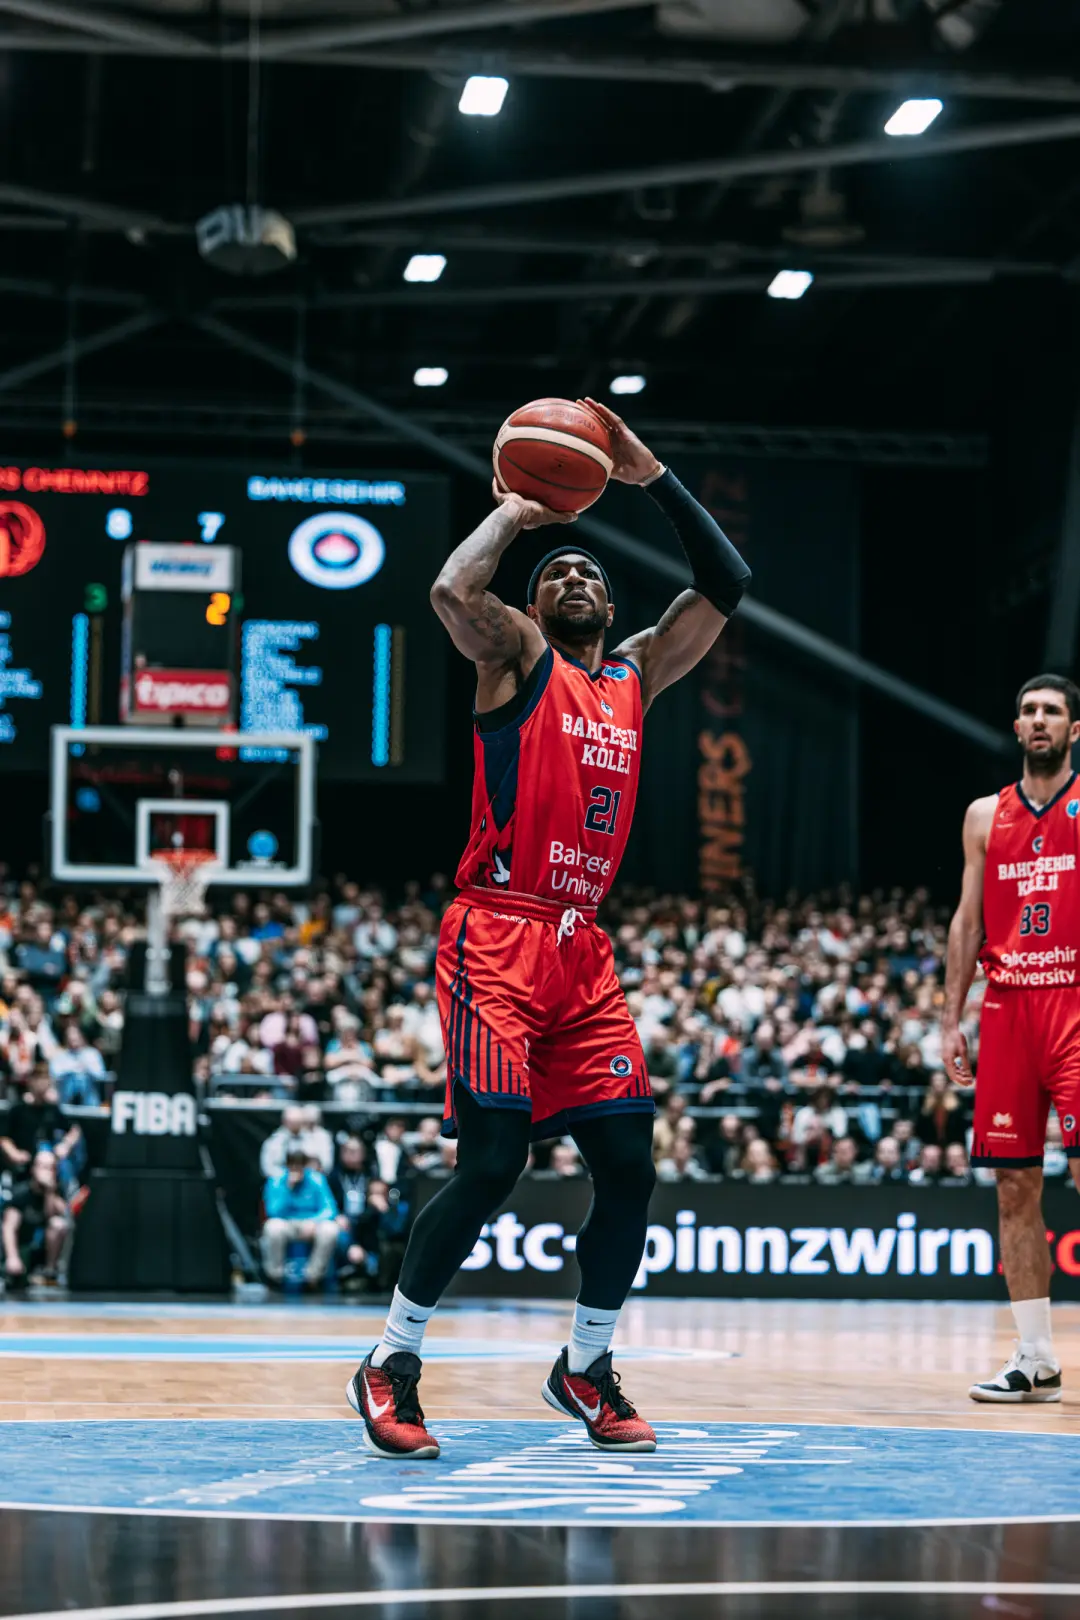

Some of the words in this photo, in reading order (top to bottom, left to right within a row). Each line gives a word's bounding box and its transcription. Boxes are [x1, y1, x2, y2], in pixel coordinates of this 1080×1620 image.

[198, 511, 225, 543] 7
[205, 592, 231, 626] 2
[584, 785, 622, 836] 21
[111, 1089, 197, 1136] FIBA
